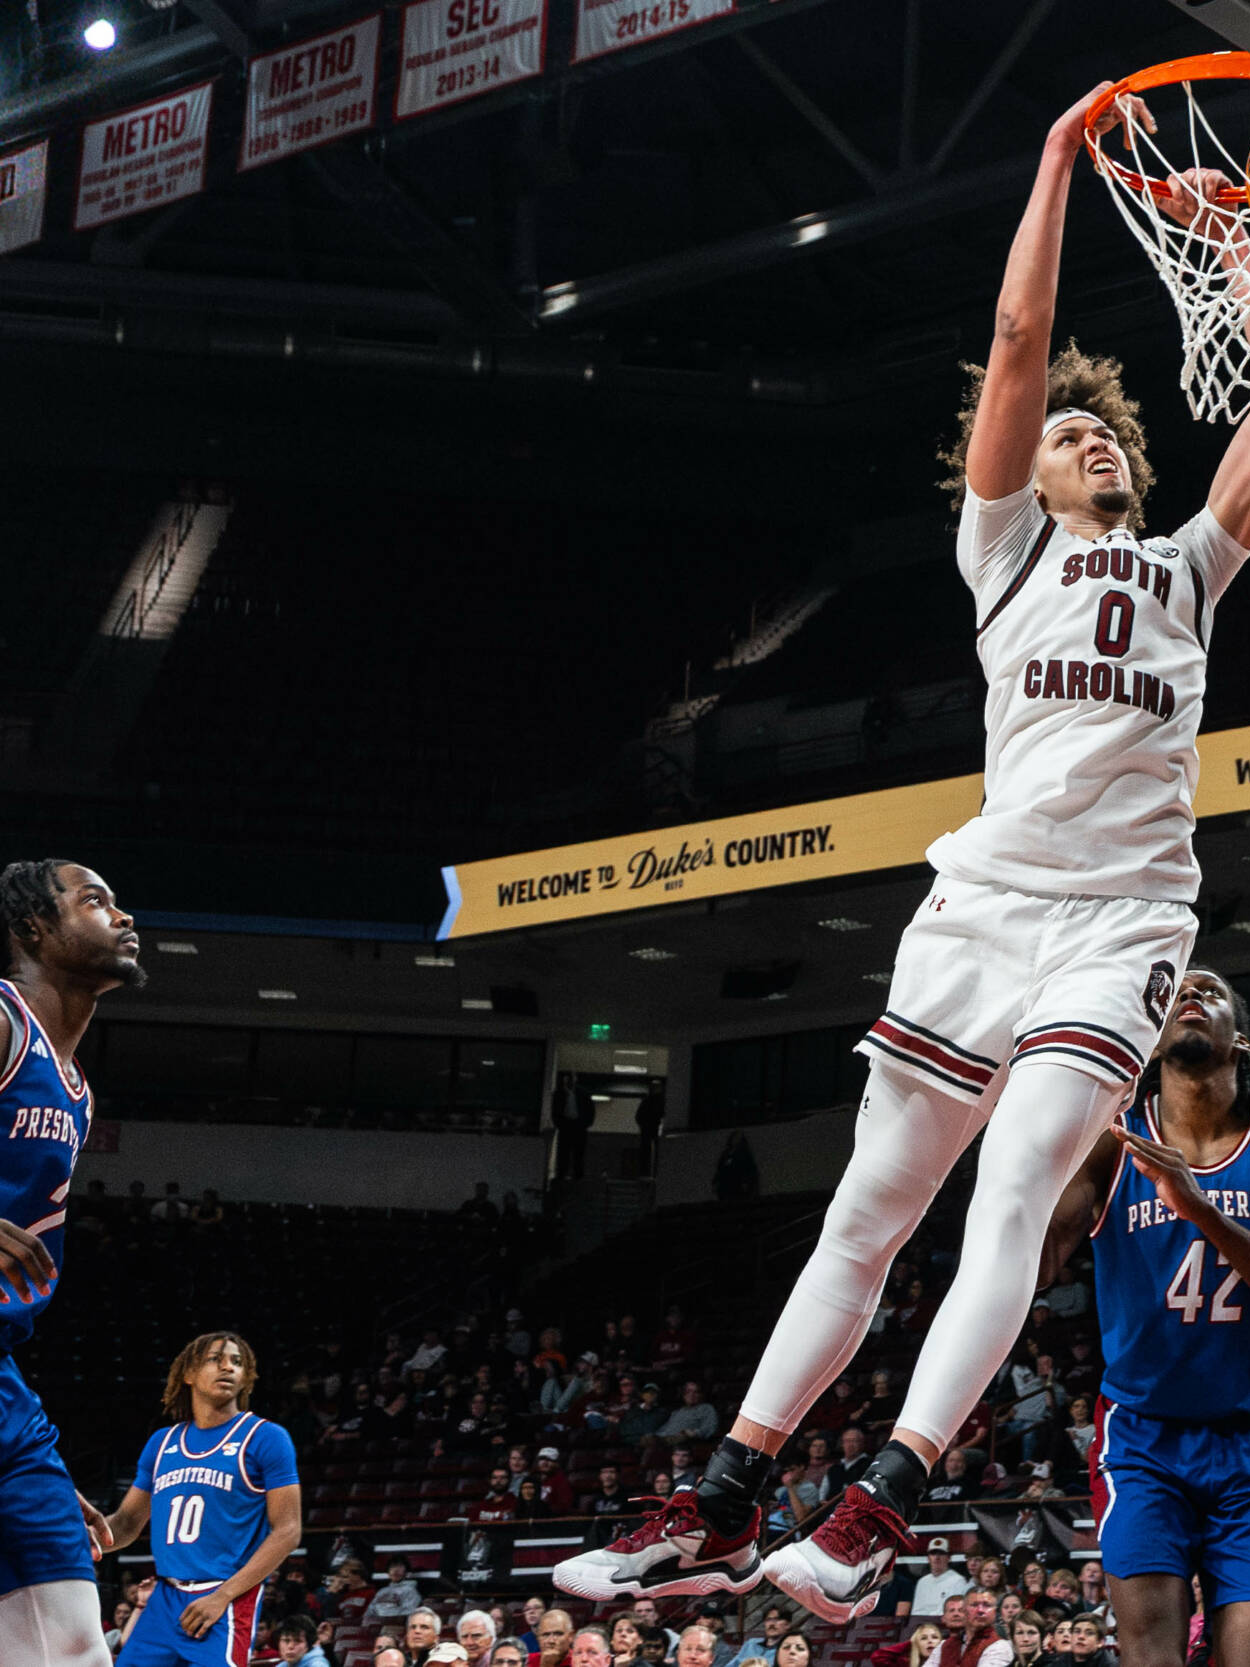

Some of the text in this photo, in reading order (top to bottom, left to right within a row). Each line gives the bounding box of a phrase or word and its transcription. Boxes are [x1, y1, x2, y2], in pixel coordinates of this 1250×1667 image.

[446, 0, 500, 39] SEC
[270, 34, 357, 99] METRO
[435, 56, 500, 97] 2013-14
[102, 101, 188, 163] METRO
[1061, 548, 1172, 610] SOUTH
[1094, 589, 1136, 659] 0
[1023, 660, 1176, 721] CAROLINA
[497, 825, 835, 907] WELCOME TO Duke's COUNTRY.
[1166, 1239, 1243, 1324] 42
[166, 1494, 206, 1546] 10
